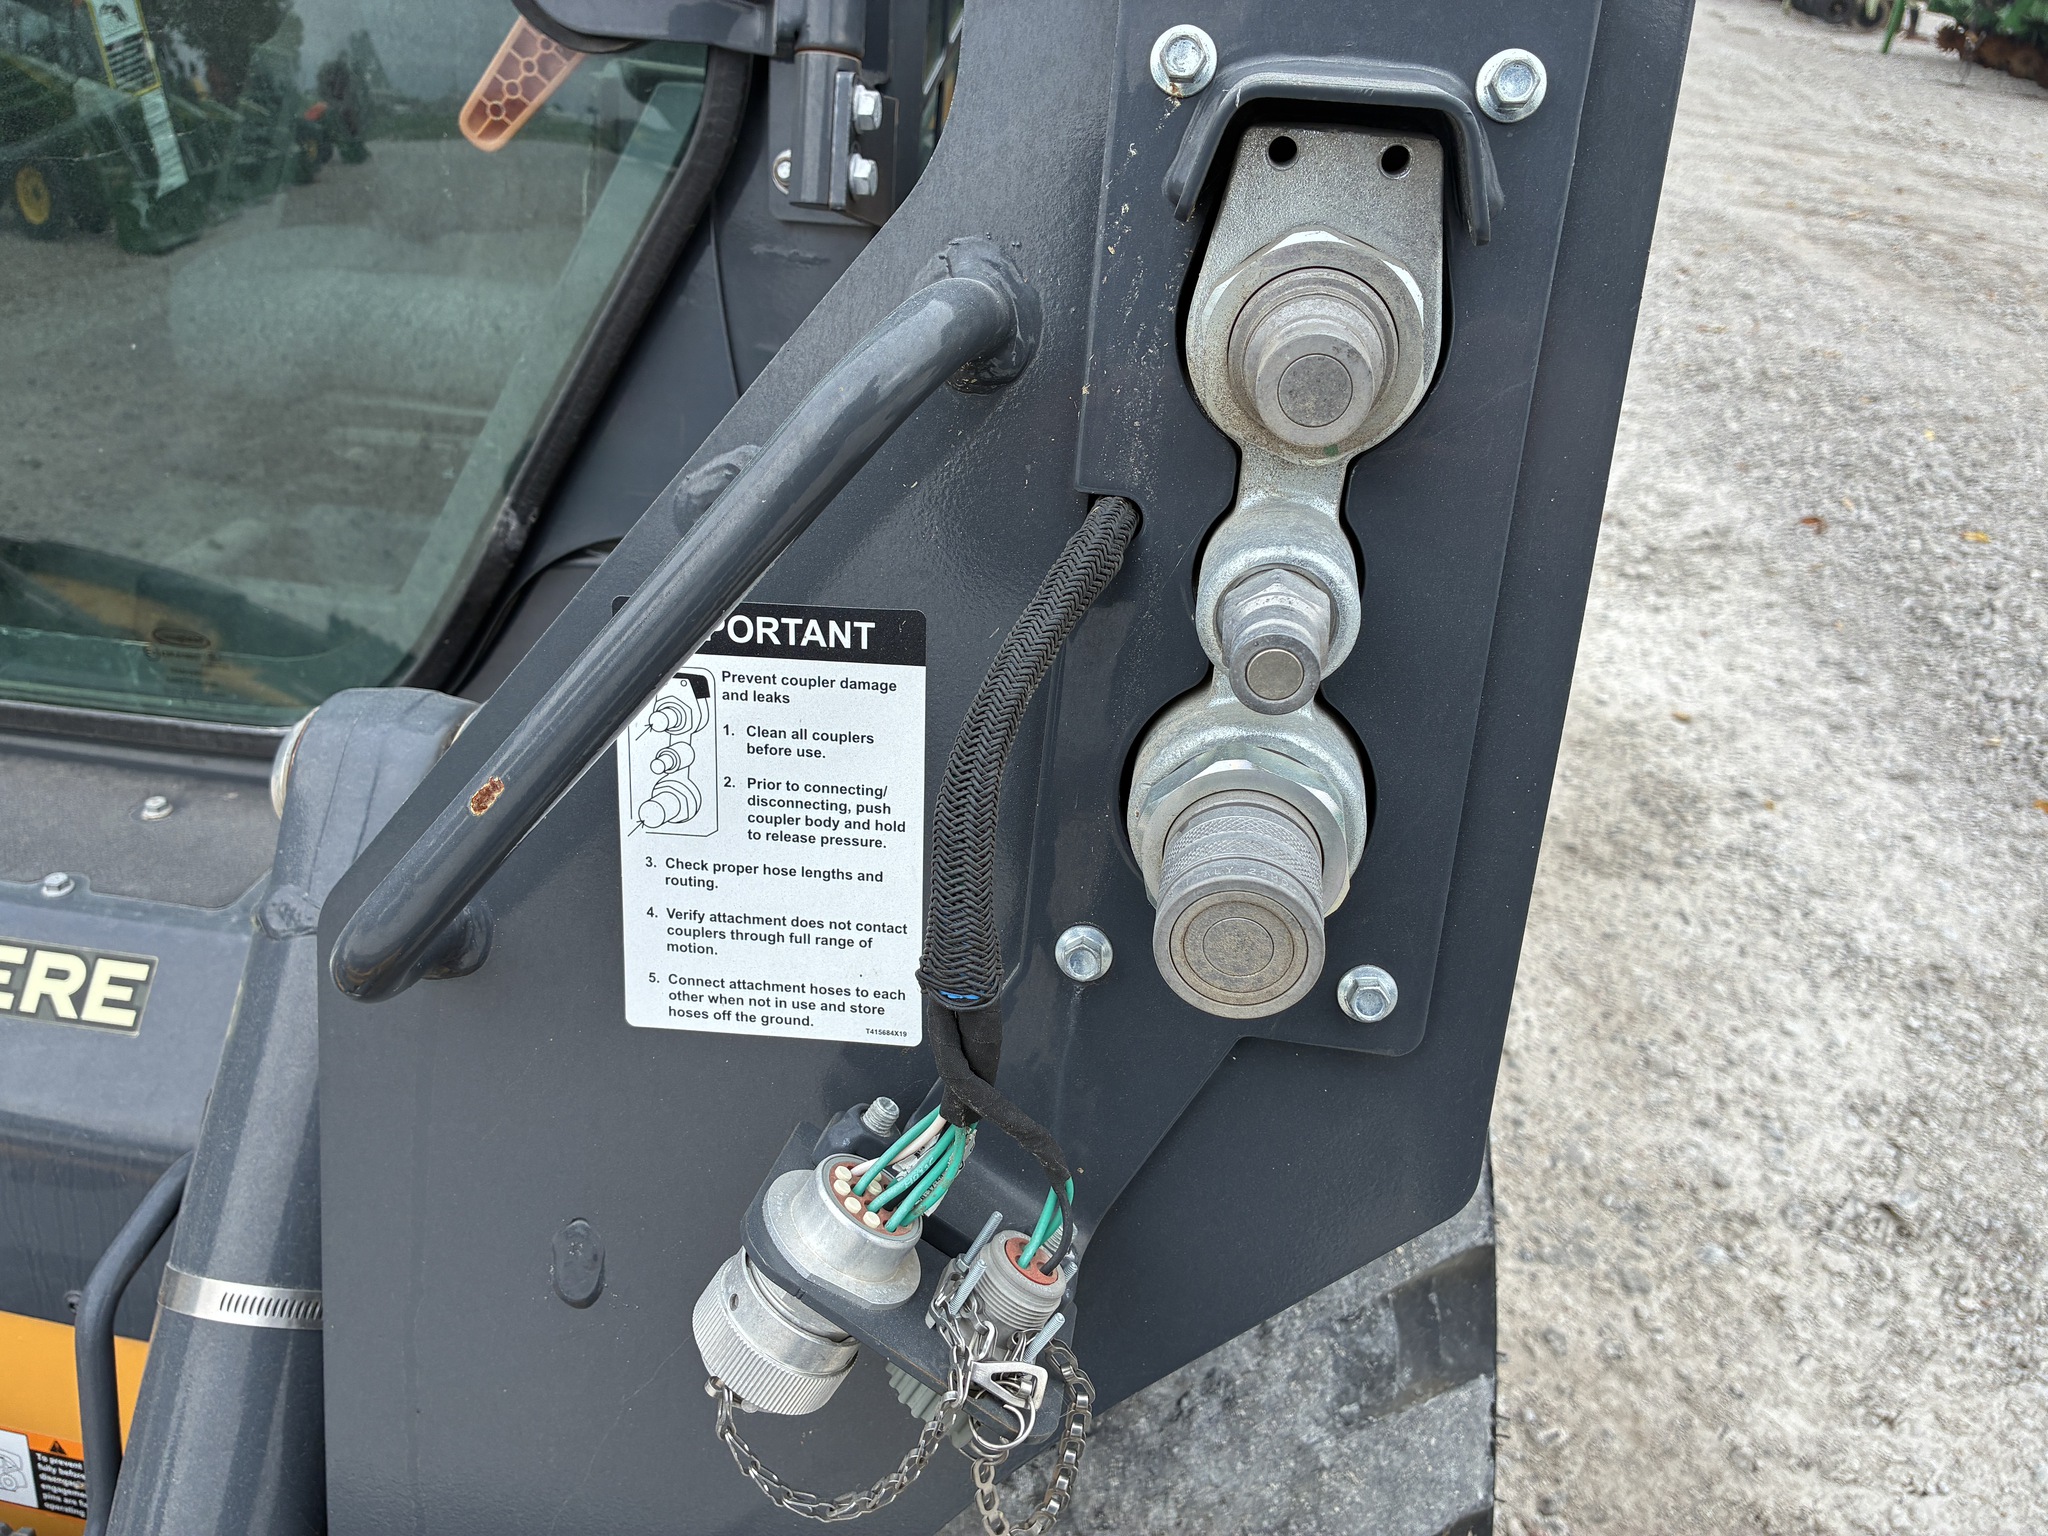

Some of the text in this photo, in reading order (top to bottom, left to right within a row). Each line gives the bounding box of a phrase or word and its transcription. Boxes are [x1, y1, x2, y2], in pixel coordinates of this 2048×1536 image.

[722, 671, 897, 694] Prevent coupler damage
[722, 690, 790, 704] and leaks
[723, 724, 874, 745] 1. Clean all couplers
[747, 742, 825, 758] before use.
[724, 776, 888, 800] 2. Prior to connecting/
[747, 795, 891, 815] disconnecting, push
[748, 813, 905, 832] coupler body and hold
[747, 829, 886, 848] to release pressure.
[645, 856, 883, 882] 3. Check proper hose lengths and
[665, 876, 718, 891] routing.
[646, 906, 907, 934] 4. Verify attachment does not contact
[667, 927, 873, 949] couplers through full range of
[667, 942, 717, 955] motion.
[0, 944, 150, 1027] RE
[649, 972, 905, 1000] 5. Connect attachment hoses to each
[669, 990, 885, 1015] other when not in use and store
[669, 1006, 813, 1026] hoses off the ground.
[866, 1027, 908, 1038] T415684X19
